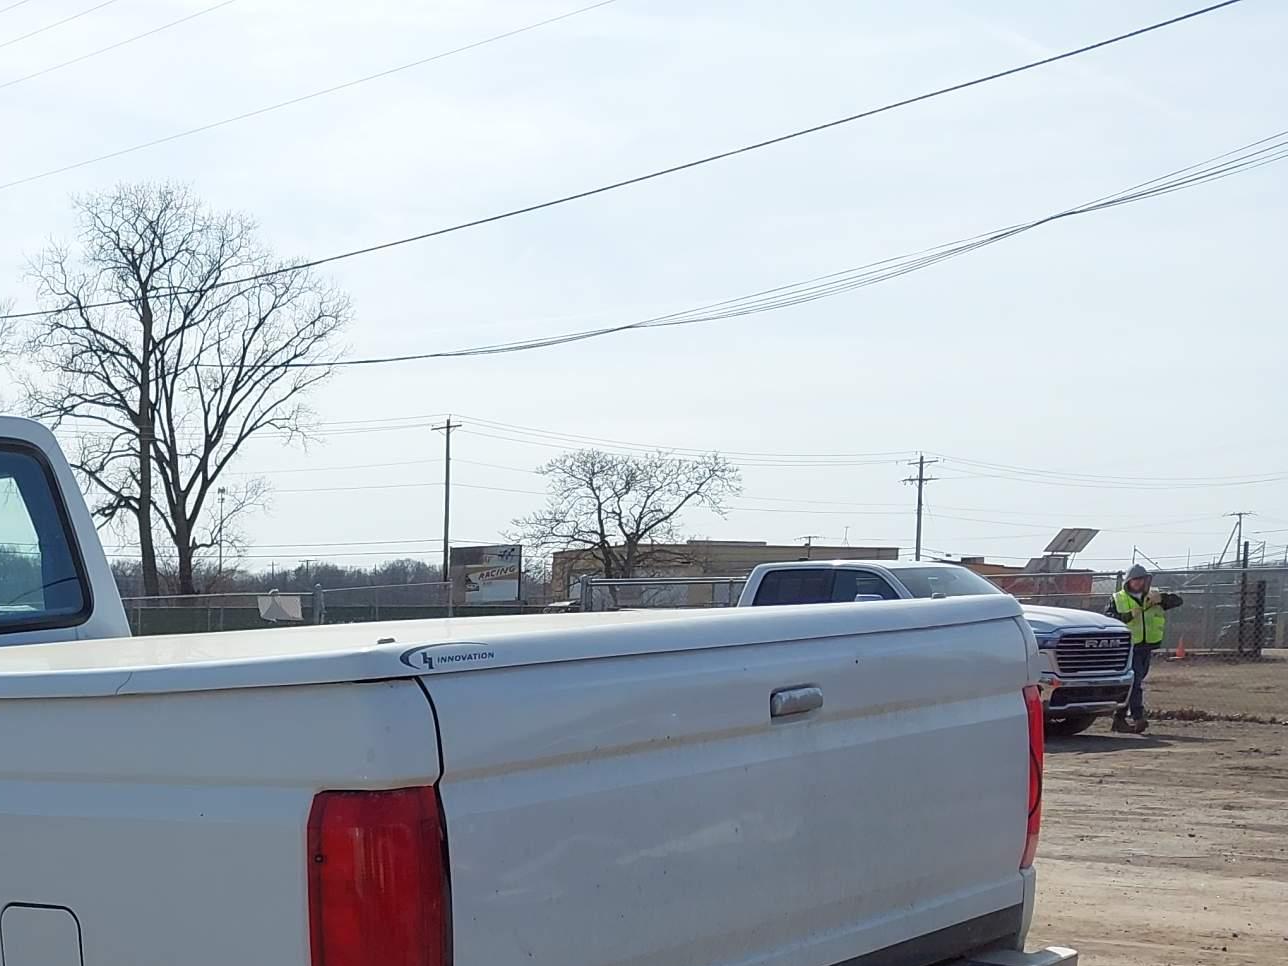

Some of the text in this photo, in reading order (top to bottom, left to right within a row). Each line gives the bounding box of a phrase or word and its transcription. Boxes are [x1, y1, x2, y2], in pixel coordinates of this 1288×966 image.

[478, 565, 516, 580] RACING
[1085, 639, 1120, 648] RAM
[437, 652, 495, 664] INNOVATION
